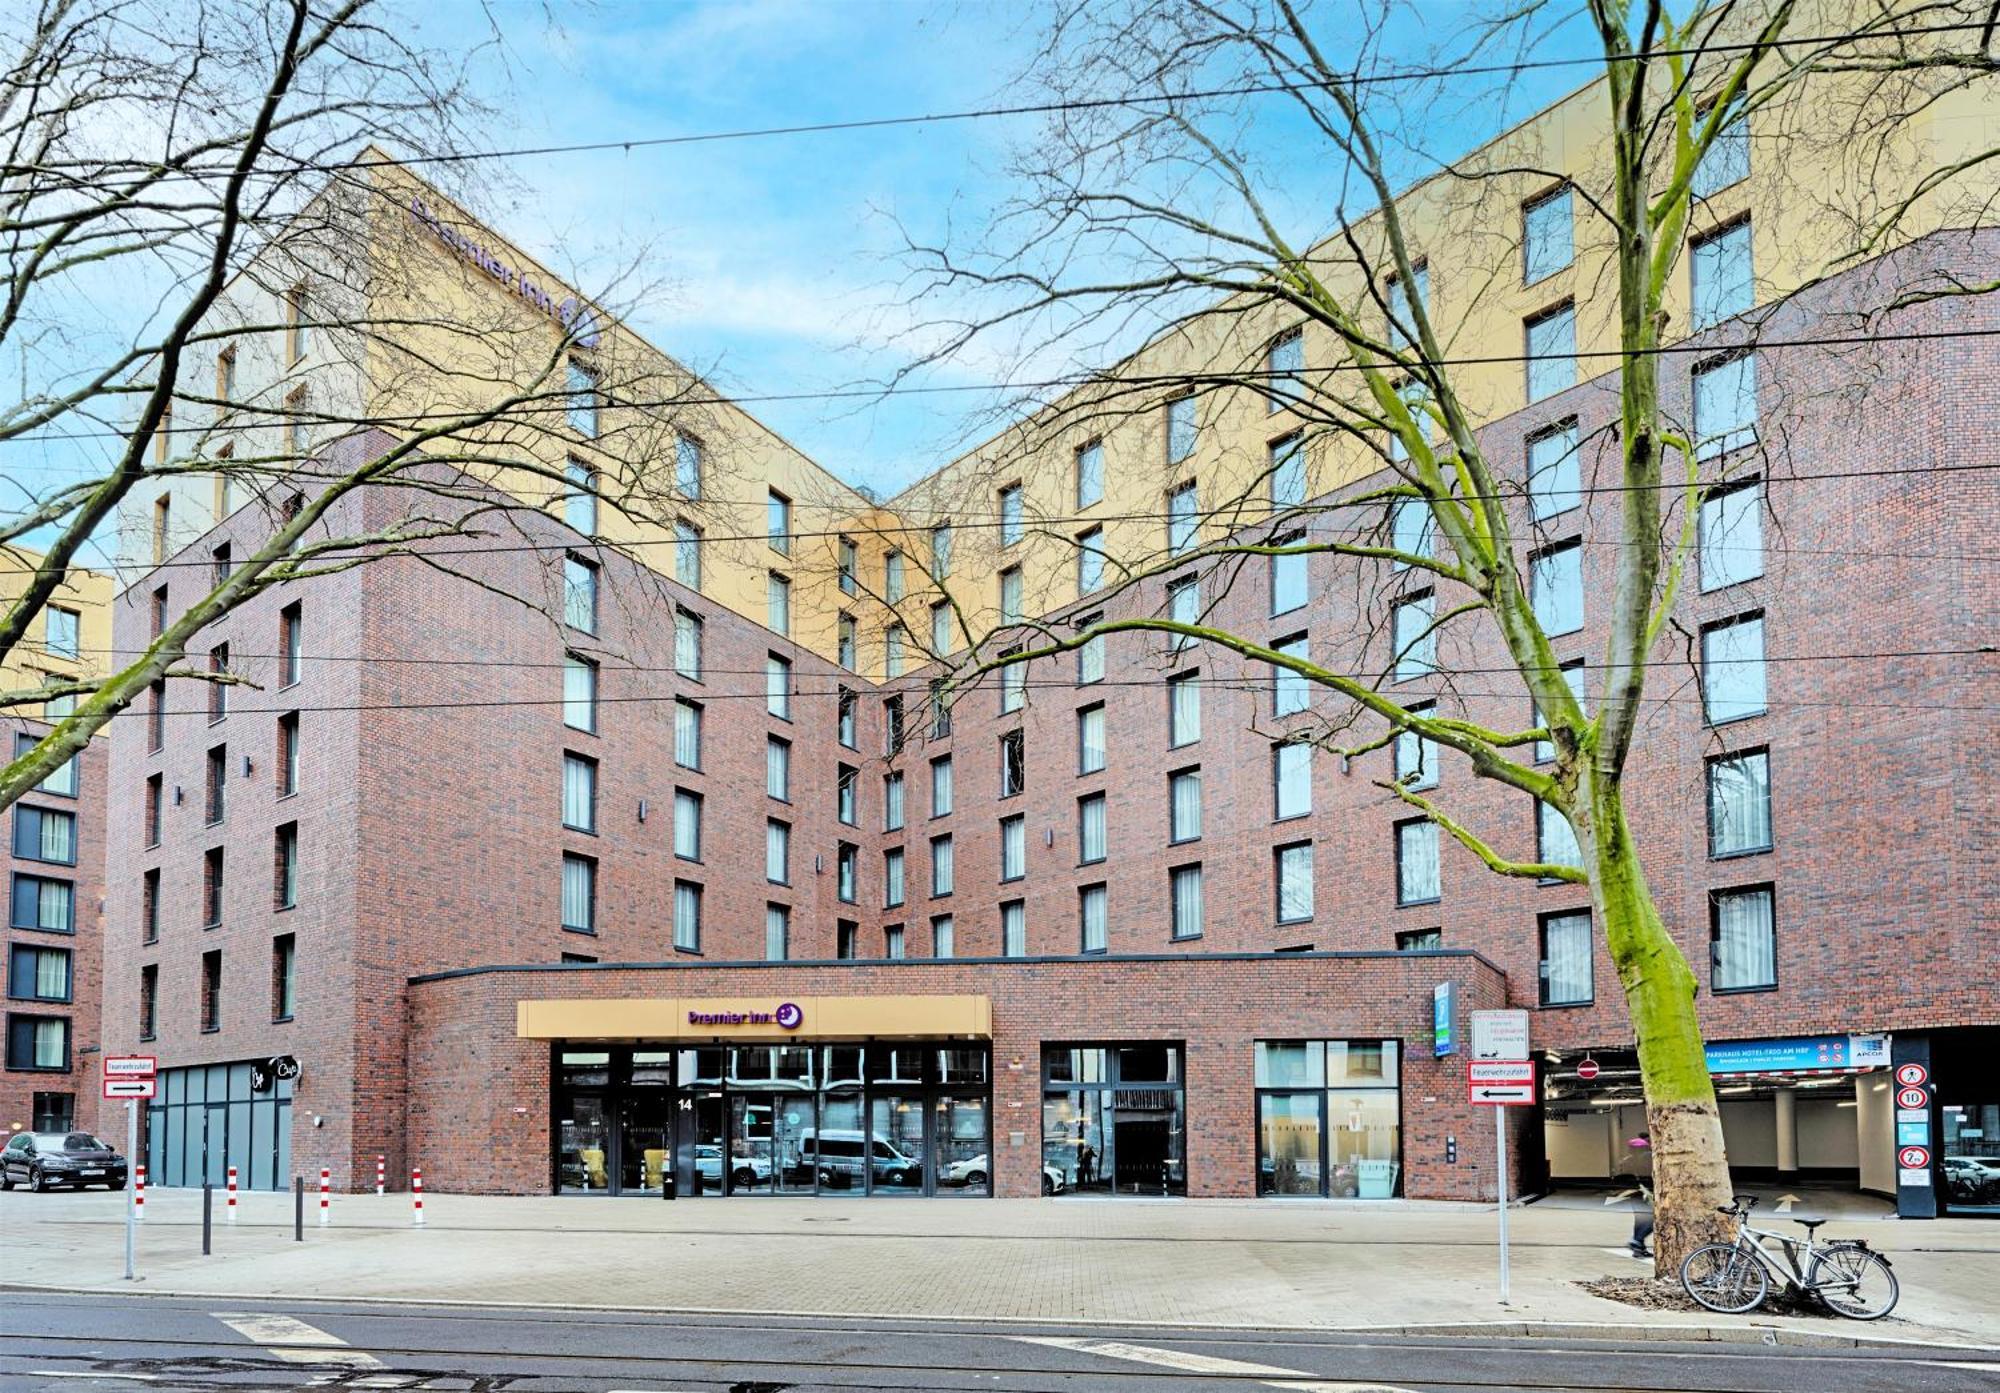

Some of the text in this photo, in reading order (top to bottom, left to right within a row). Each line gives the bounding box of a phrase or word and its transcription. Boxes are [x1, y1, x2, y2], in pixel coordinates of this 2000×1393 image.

[688, 1011, 747, 1024] Premier
[1905, 1093, 1919, 1103] 10
[678, 1099, 692, 1110] 14
